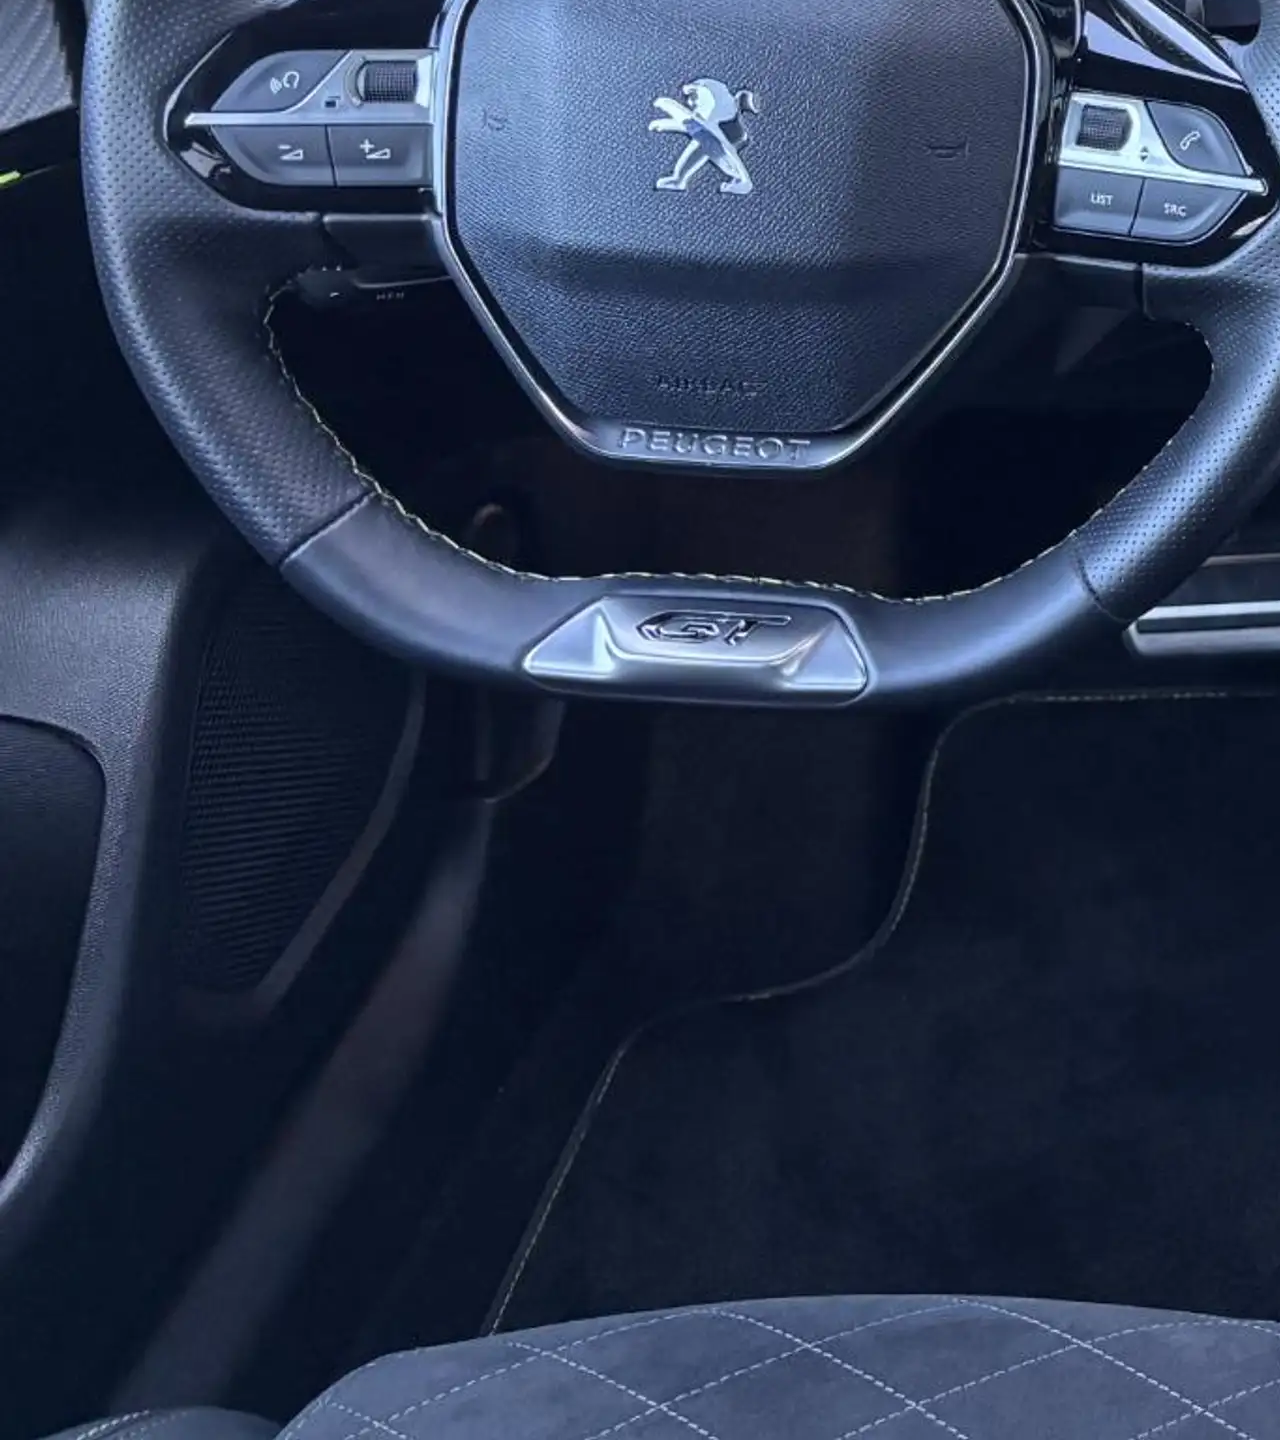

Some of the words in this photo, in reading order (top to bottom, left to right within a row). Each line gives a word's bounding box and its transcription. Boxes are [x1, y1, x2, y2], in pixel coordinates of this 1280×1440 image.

[1090, 192, 1114, 206] LIST
[1163, 201, 1187, 218] SRC
[617, 427, 811, 461] PEUGEOT
[635, 608, 792, 647] GT
